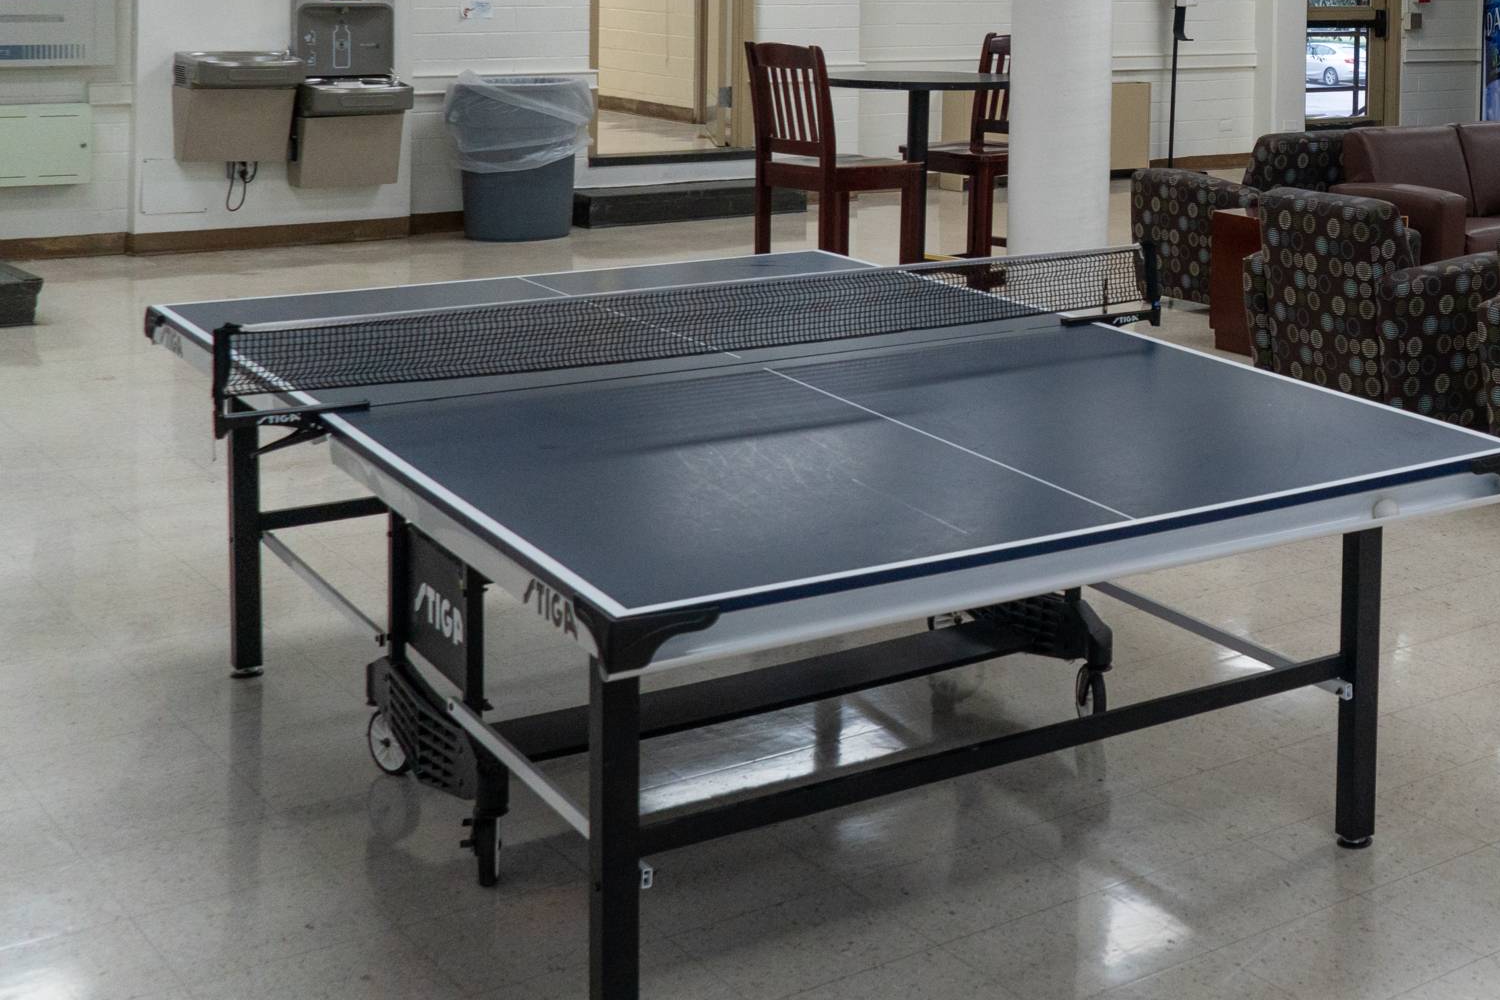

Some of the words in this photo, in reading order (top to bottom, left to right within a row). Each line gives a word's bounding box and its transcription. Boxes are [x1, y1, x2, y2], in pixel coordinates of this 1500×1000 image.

[1112, 314, 1139, 324] STIGA
[256, 413, 301, 425] STIGA
[414, 582, 463, 645] STIGA
[523, 578, 578, 640] STIGA
